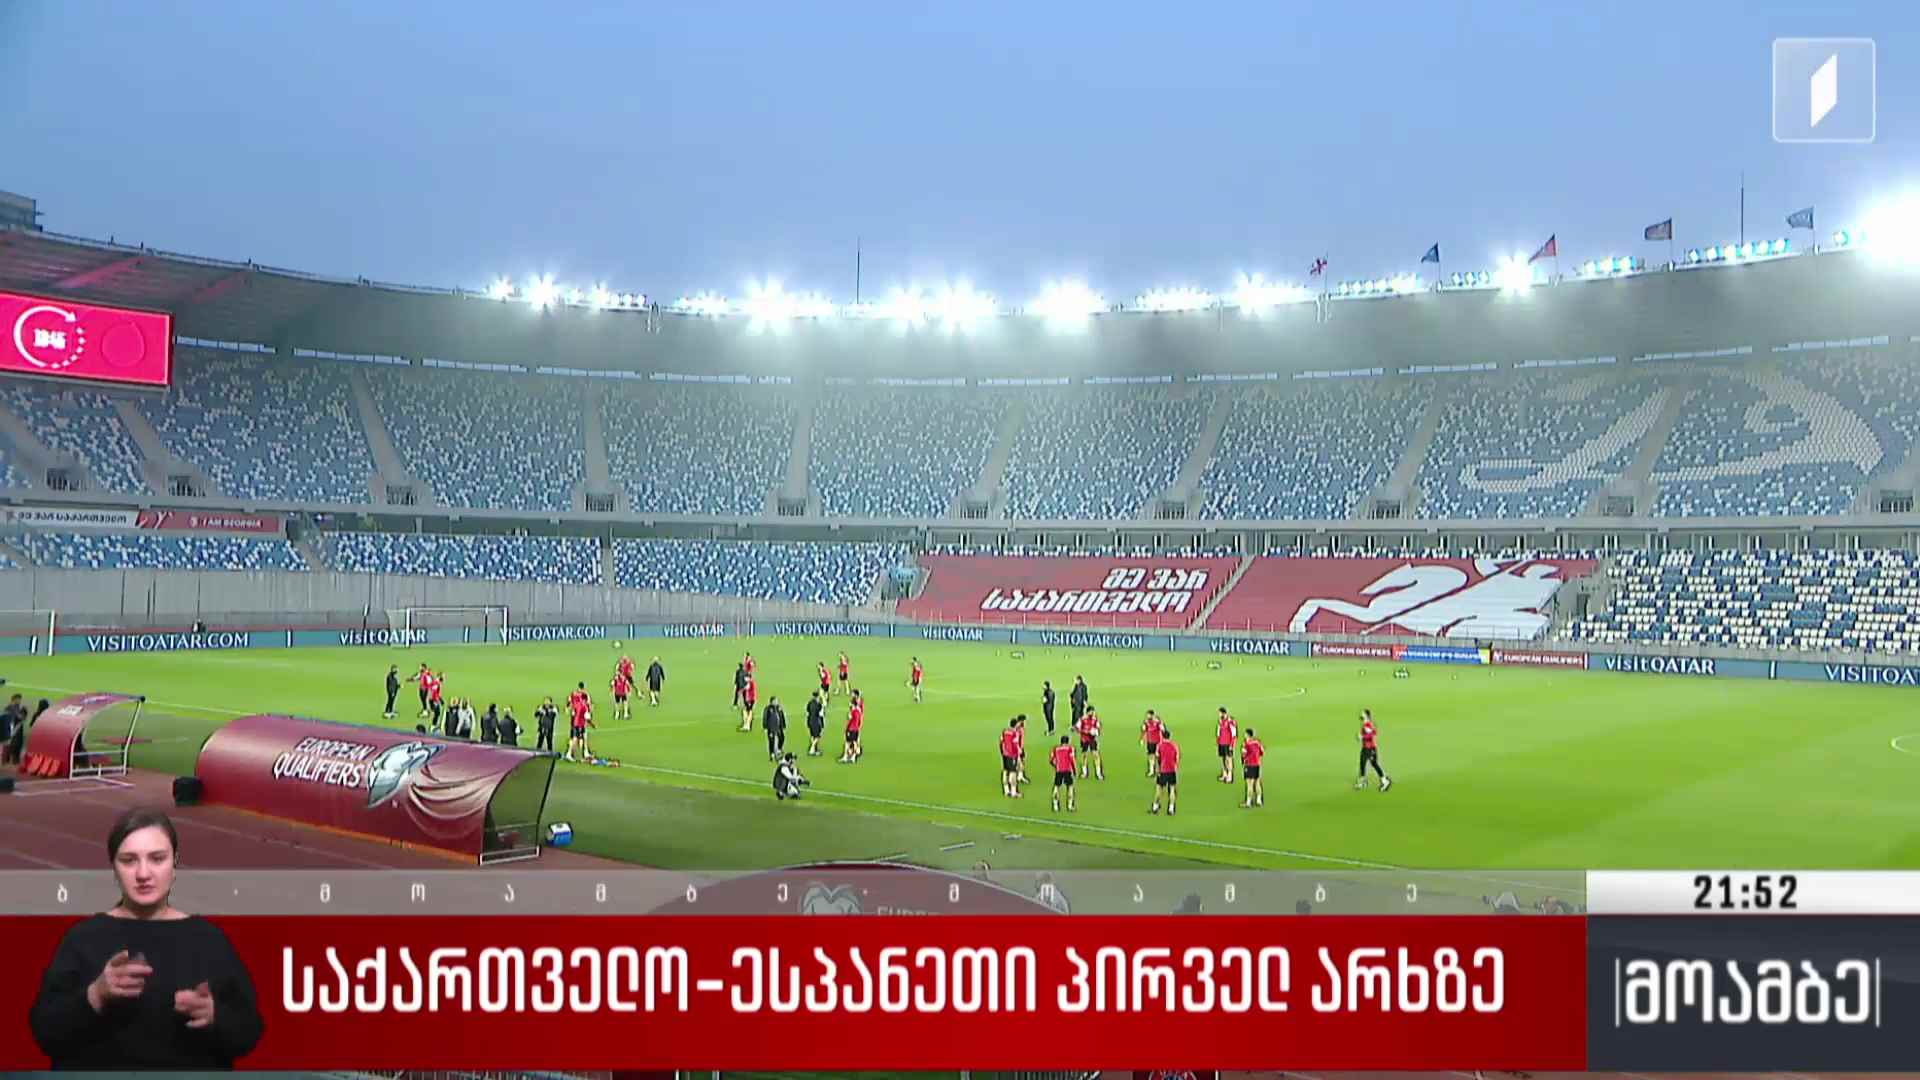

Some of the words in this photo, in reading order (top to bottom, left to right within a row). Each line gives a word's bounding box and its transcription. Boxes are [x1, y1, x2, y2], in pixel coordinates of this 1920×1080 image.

[1102, 568, 1146, 589] მე
[1148, 568, 1207, 589] ვარ
[981, 589, 1191, 613] საქართველო
[1210, 638, 1290, 655] visitQATAR
[1605, 655, 1715, 675] visitQATAR
[1825, 664, 1920, 686] VISITQA
[297, 737, 374, 760] EUROPEAN
[274, 753, 362, 787] QUALIFIERS
